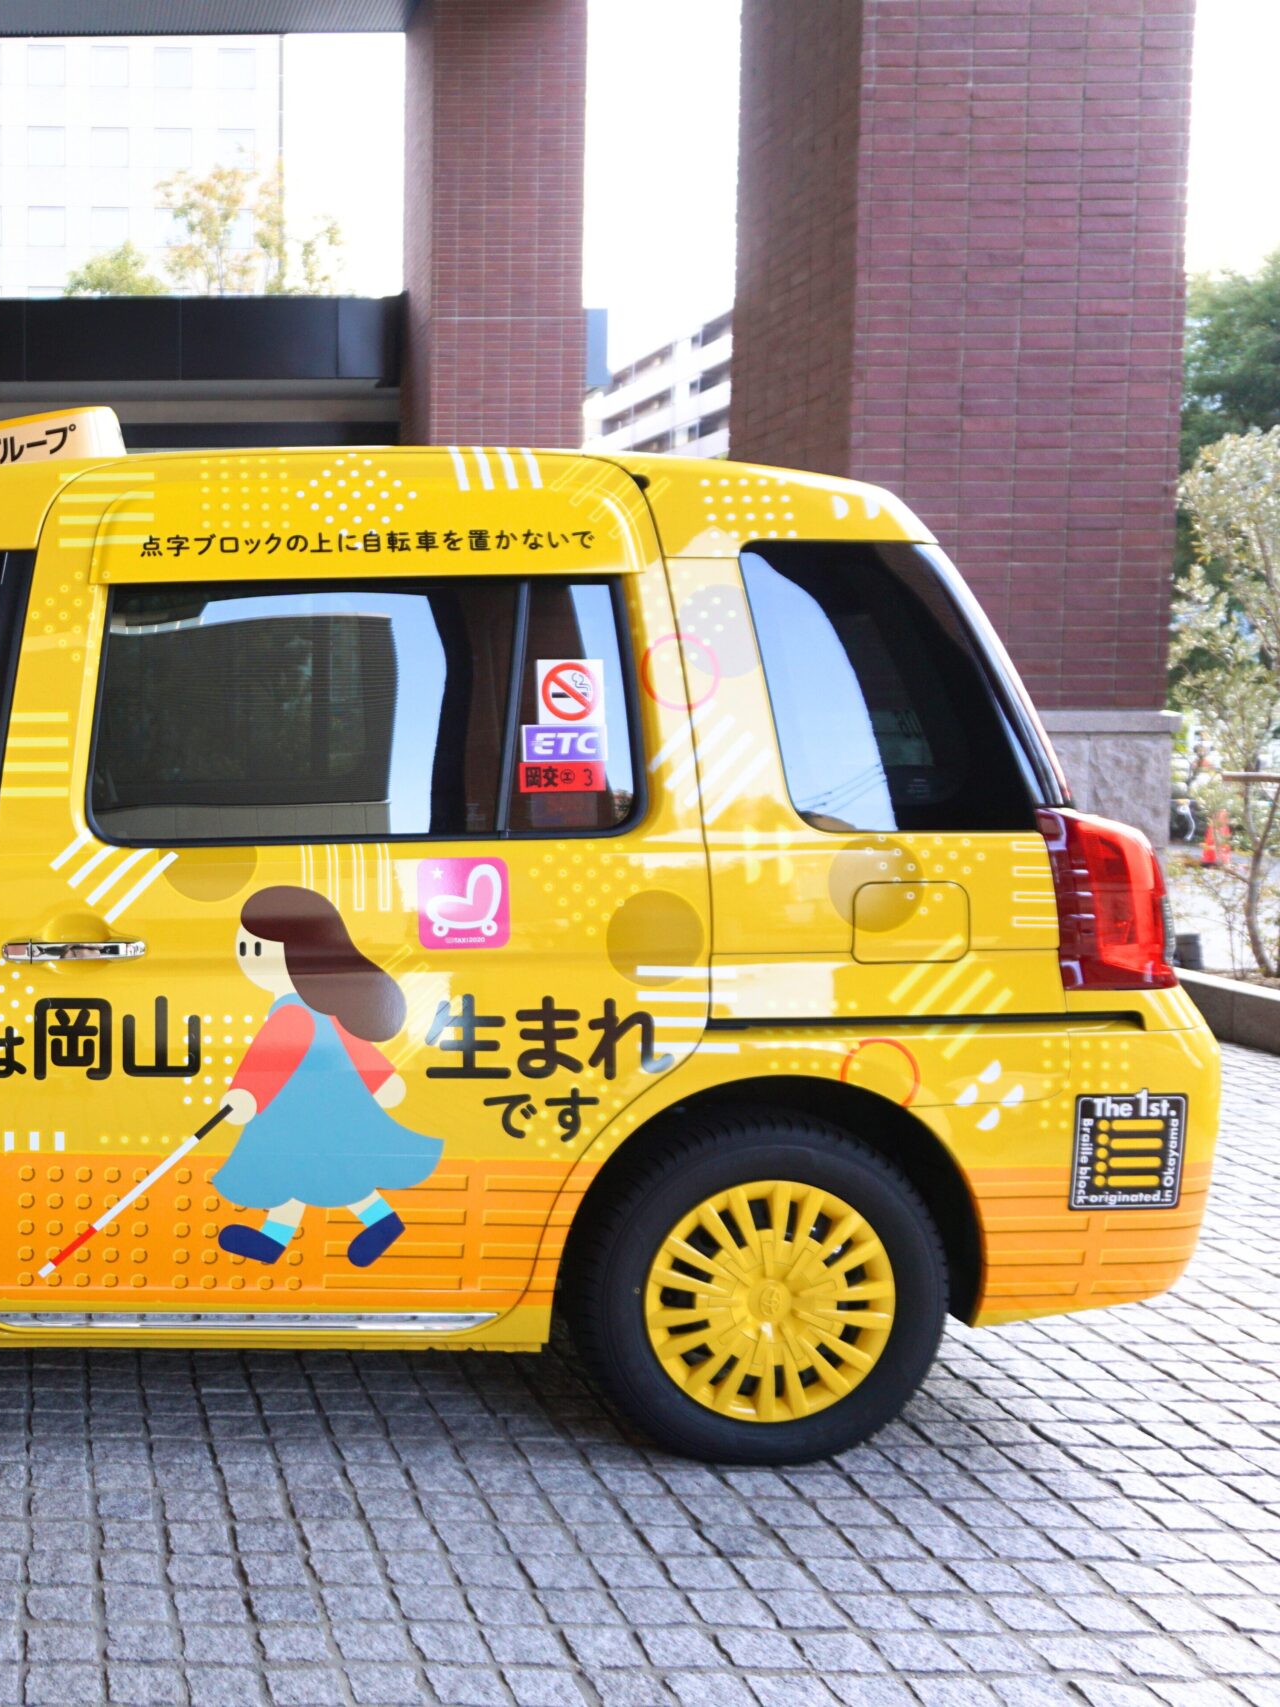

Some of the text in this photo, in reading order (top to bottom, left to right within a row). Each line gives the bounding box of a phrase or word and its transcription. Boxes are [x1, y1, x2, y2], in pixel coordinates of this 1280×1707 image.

[139, 529, 597, 559] 点字ブロックの上に自転車を置かないで
[531, 732, 600, 756] ETC
[583, 768, 593, 787] 3
[483, 1087, 601, 1143] です
[1093, 1088, 1177, 1117] The 1st.
[1076, 1118, 1094, 1204] Braille block
[1161, 1118, 1180, 1202] in Okayama
[1089, 1190, 1161, 1206] originated
